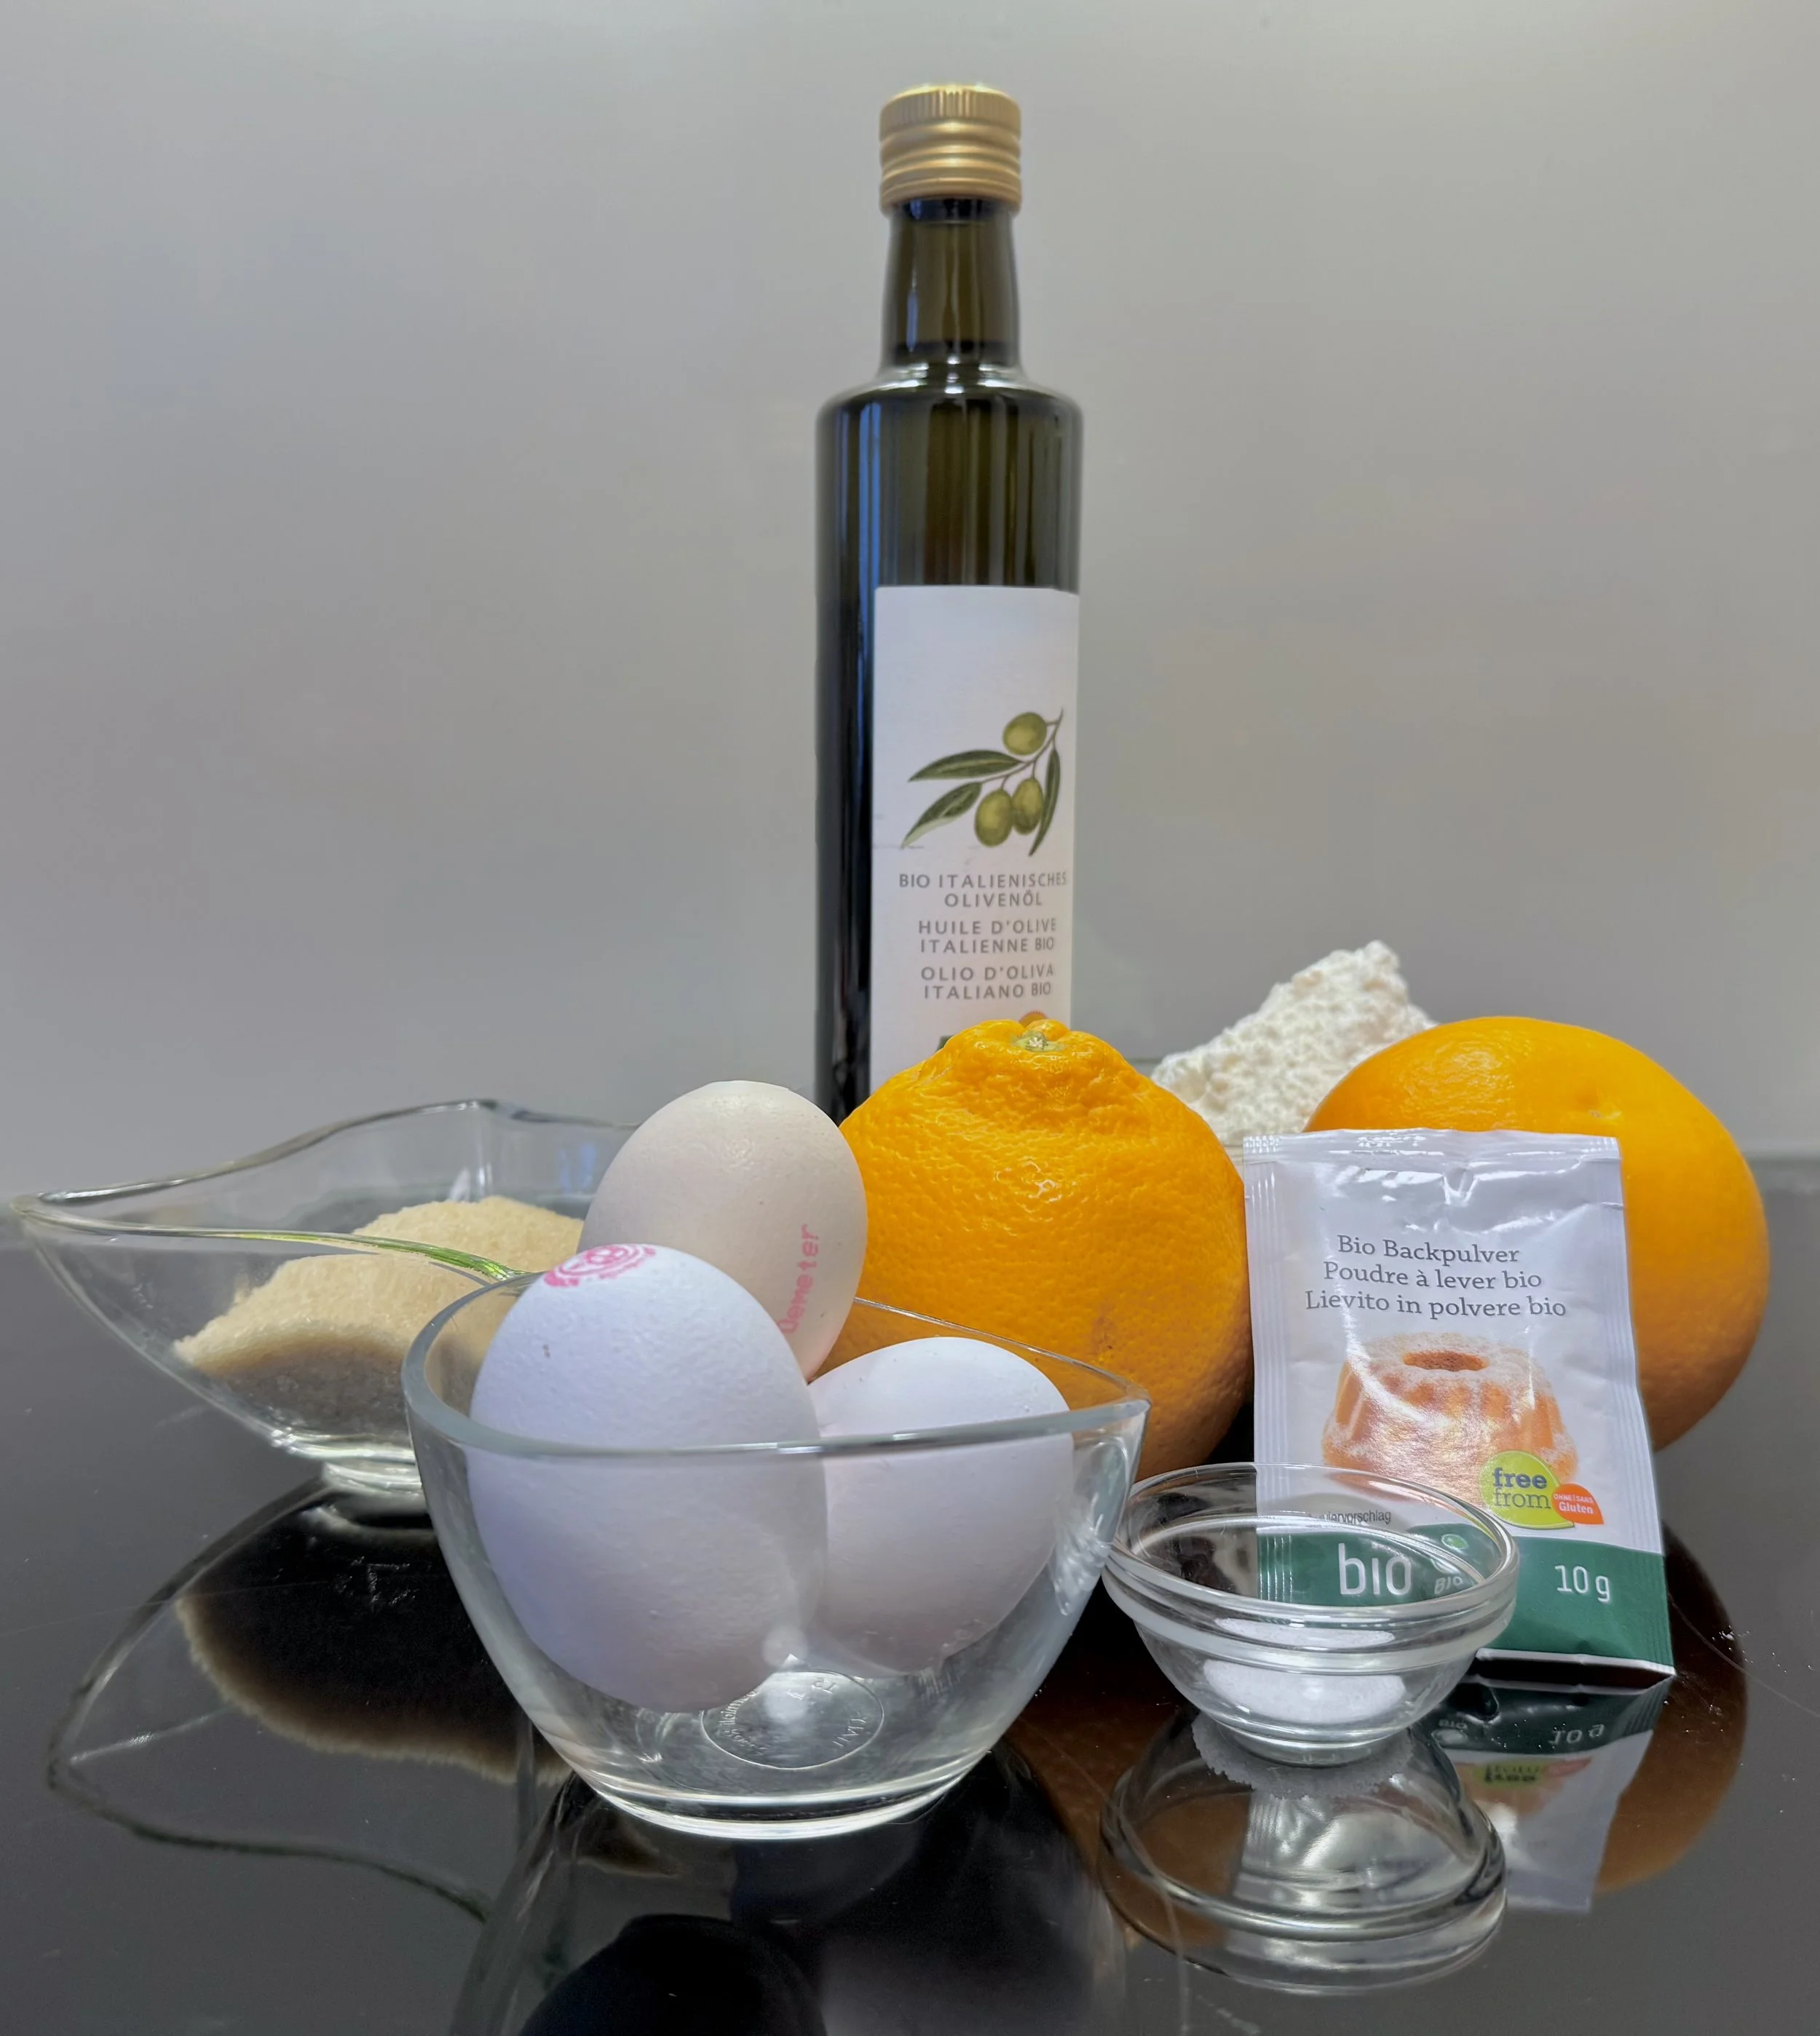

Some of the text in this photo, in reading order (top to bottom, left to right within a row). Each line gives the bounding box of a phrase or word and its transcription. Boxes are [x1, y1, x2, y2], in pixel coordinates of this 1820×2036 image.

[899, 871, 1067, 888] BIO ITALIENISCHES
[944, 890, 1042, 908] OLIVENÖL
[919, 918, 1057, 935] HUILE D'OLIVE
[921, 937, 1055, 954] ITALIENNE BIO
[921, 964, 1054, 981] OLIO D'OLIVA
[925, 982, 1051, 999] ITALIANO BIO
[1337, 1235, 1519, 1267] Bio Backpulver
[1324, 1261, 1542, 1289] Poudre à lever bio
[1305, 1290, 1567, 1320] Lievito in polvere bio
[1492, 1467, 1548, 1489] free
[1494, 1487, 1552, 1509] from
[1559, 1502, 1594, 1514] Gluten
[1338, 1542, 1412, 1596] bio
[1434, 1576, 1463, 1595] BIO
[1554, 1564, 1611, 1603] 10 g
